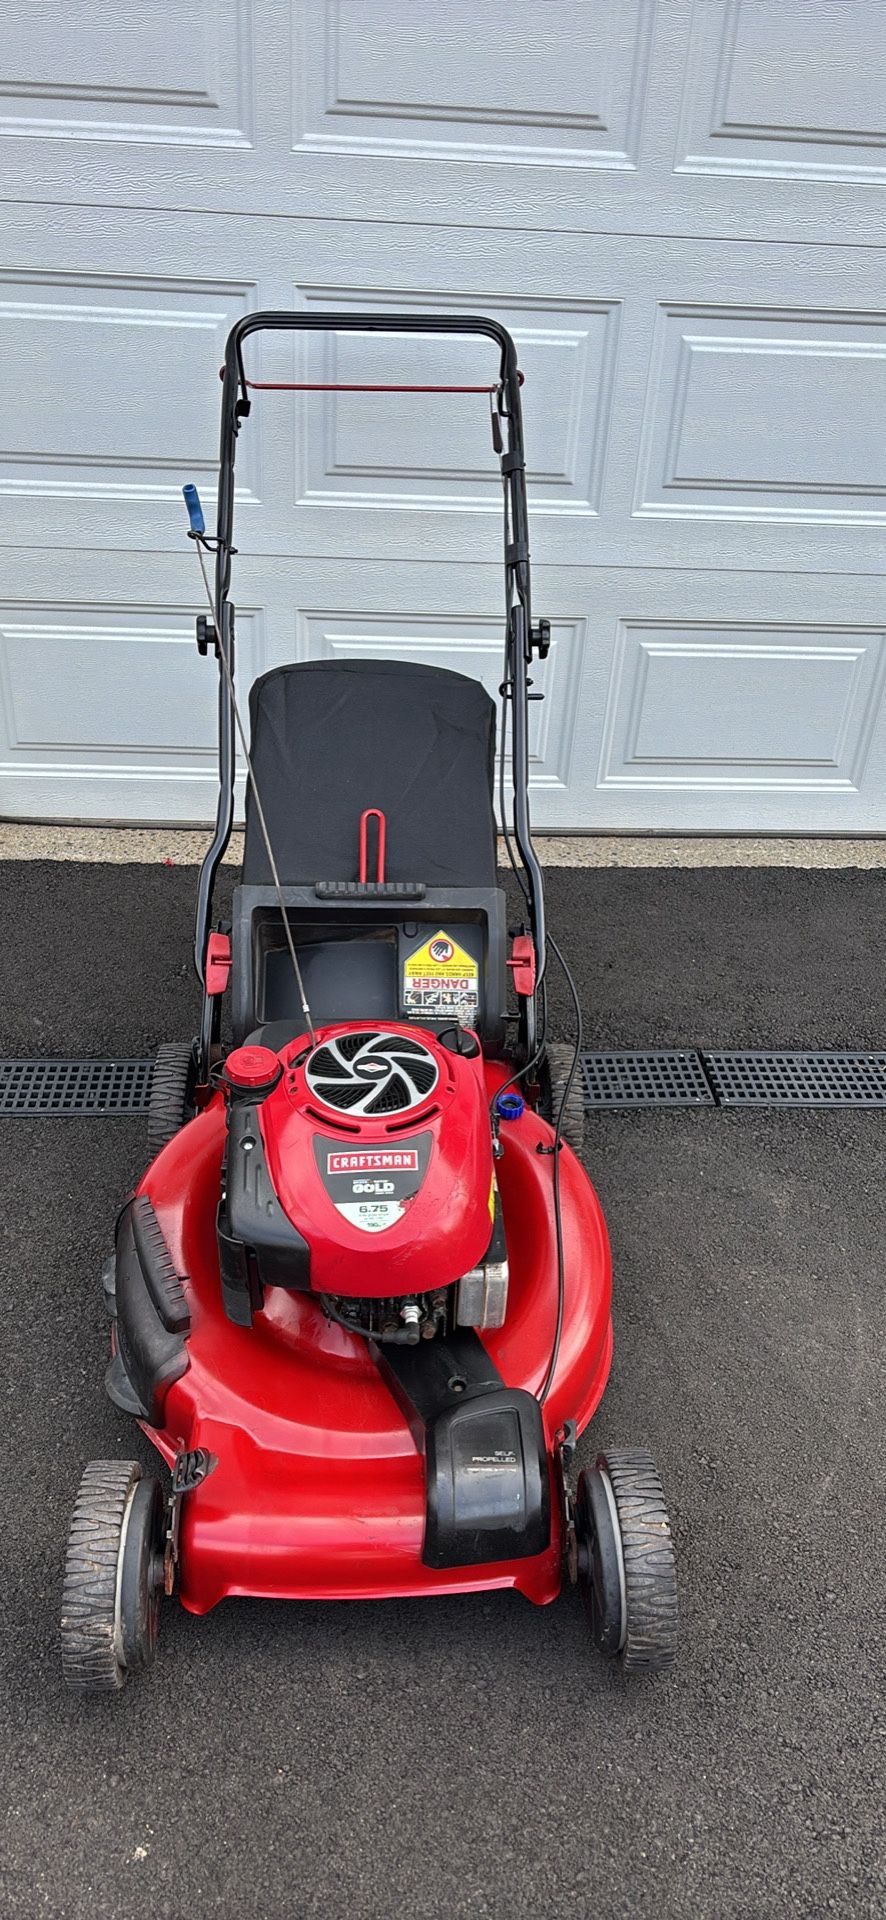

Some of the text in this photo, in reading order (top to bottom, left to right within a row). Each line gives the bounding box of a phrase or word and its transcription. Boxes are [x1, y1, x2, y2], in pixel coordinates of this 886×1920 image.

[412, 979, 469, 989] DANGER
[333, 1155, 411, 1168] CRAFTSMAN
[352, 1182, 395, 1193] GOLD
[359, 1205, 388, 1213] 6.75
